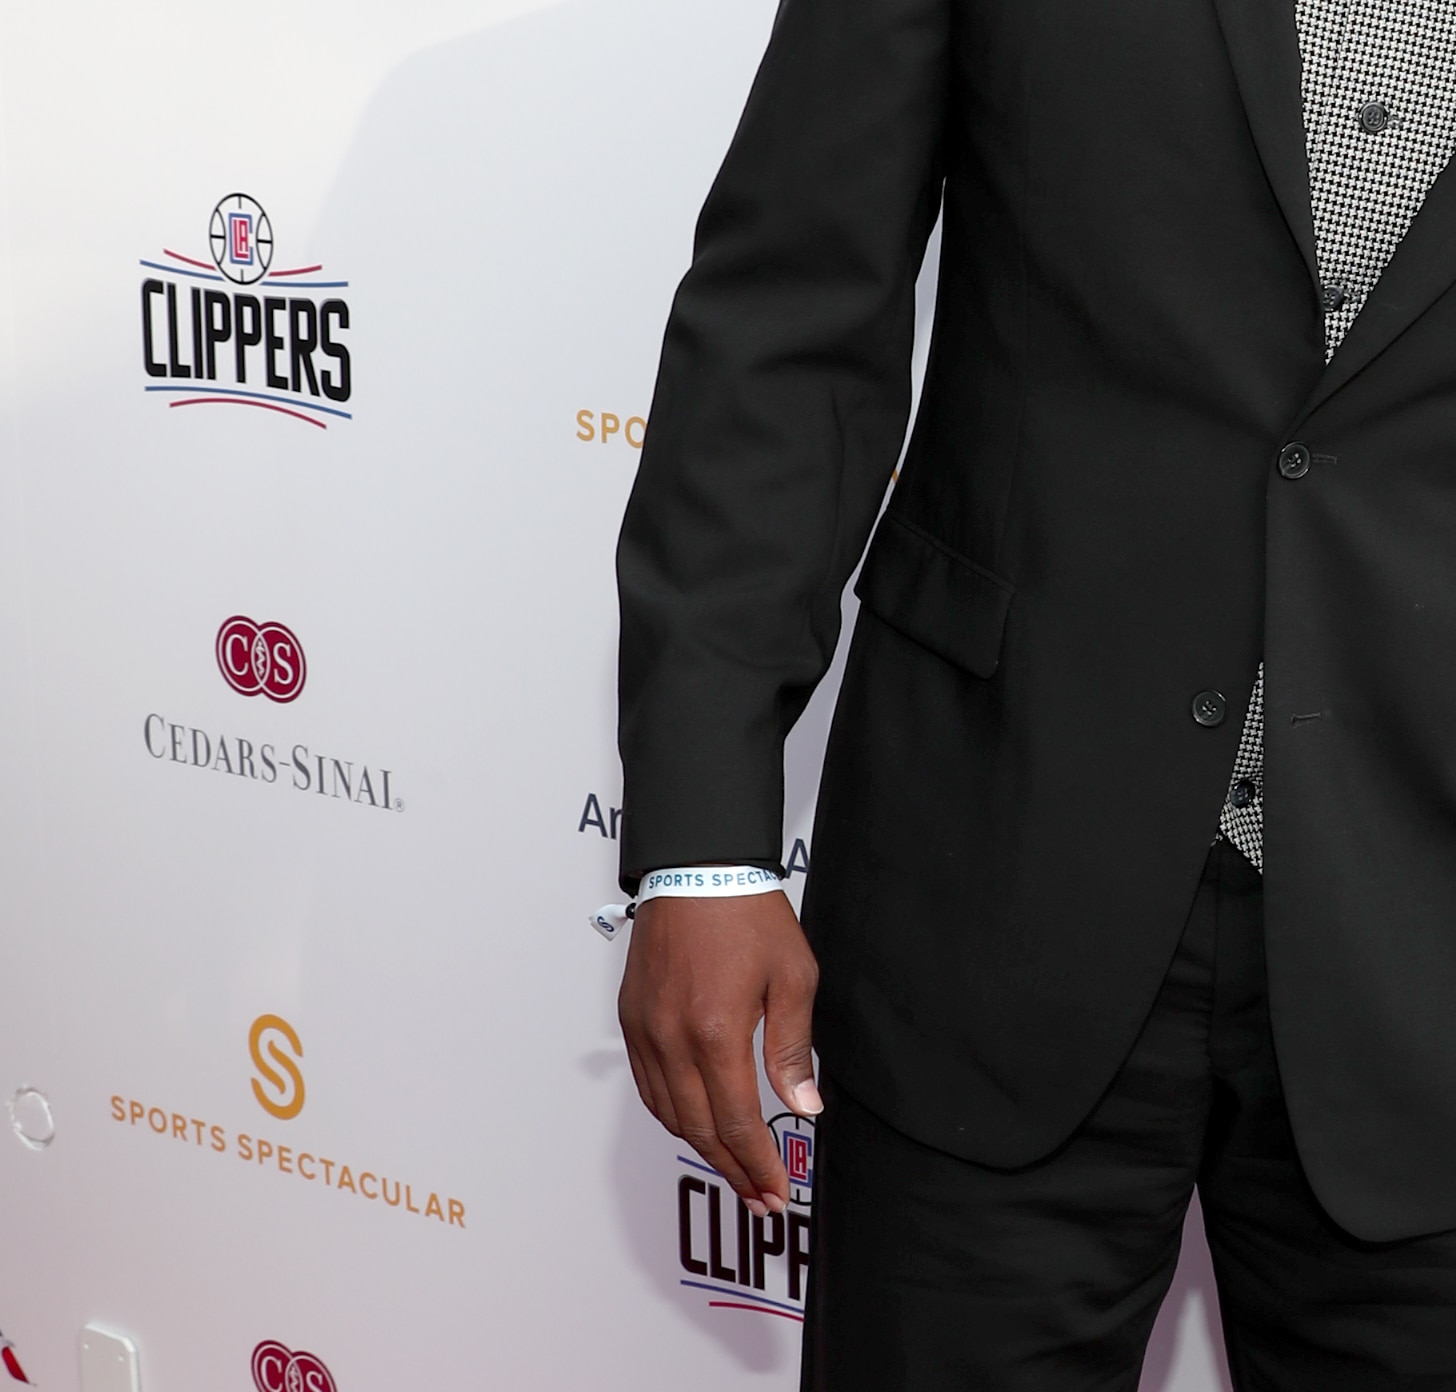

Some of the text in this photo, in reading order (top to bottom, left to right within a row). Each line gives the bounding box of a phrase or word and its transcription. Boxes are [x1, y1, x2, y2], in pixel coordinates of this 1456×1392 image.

[141, 277, 352, 404] CLIPPERS
[648, 873, 705, 889] SPORTS
[110, 1095, 467, 1229] SPORTS SPECTACULAR
